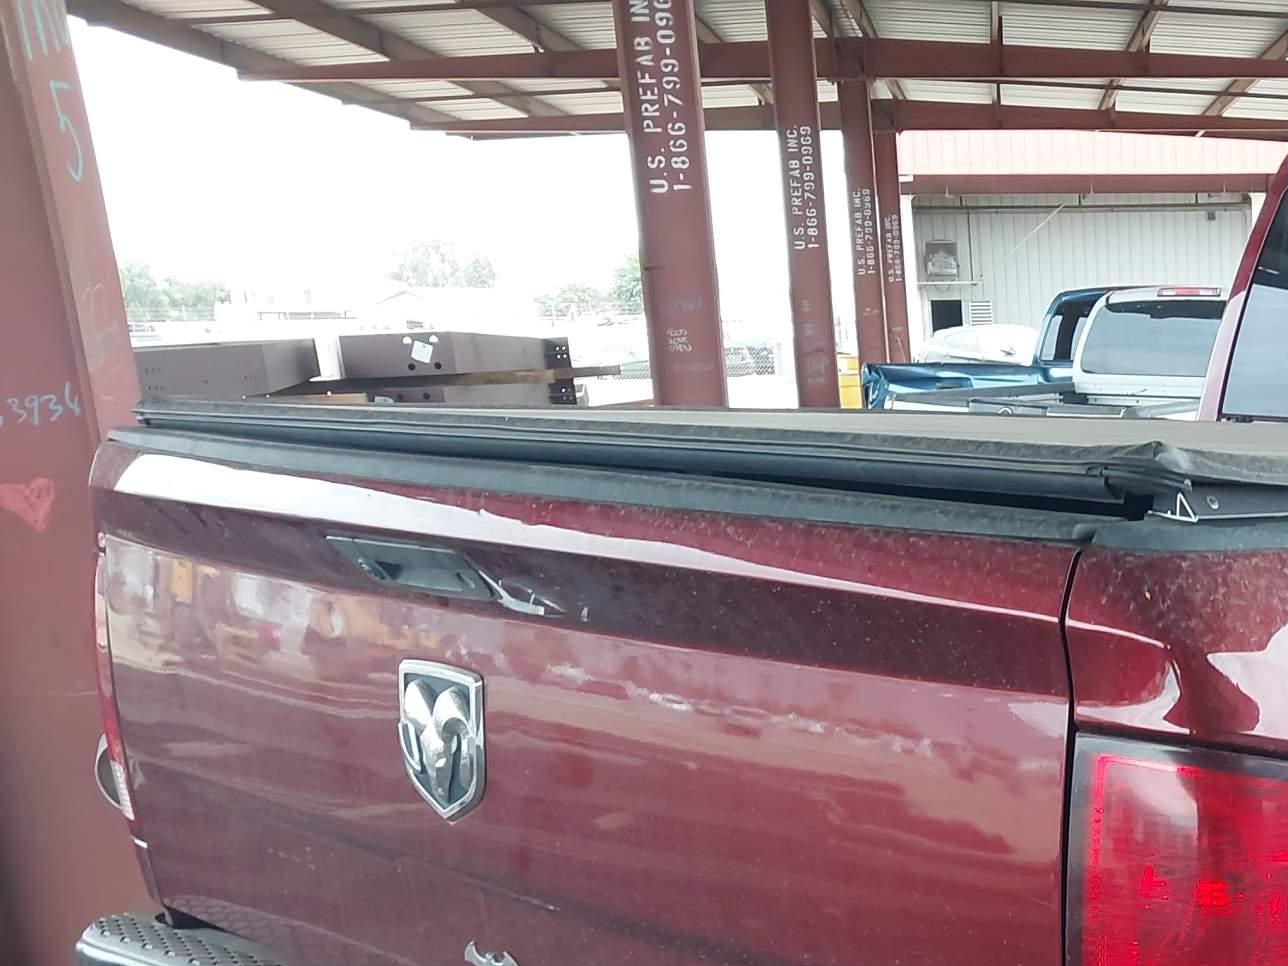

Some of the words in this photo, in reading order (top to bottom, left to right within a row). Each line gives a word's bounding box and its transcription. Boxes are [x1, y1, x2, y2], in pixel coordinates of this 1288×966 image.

[633, 36, 663, 133] PREFAB
[786, 125, 799, 152] INC.
[646, 147, 670, 194] U.S.
[788, 158, 803, 215] PREFAB
[800, 126, 820, 249] 1-866-799-0969
[792, 219, 806, 250] U.S.
[855, 211, 865, 251] PREFAB
[857, 254, 866, 276] U.S.
[0, 381, 81, 427] 3934
